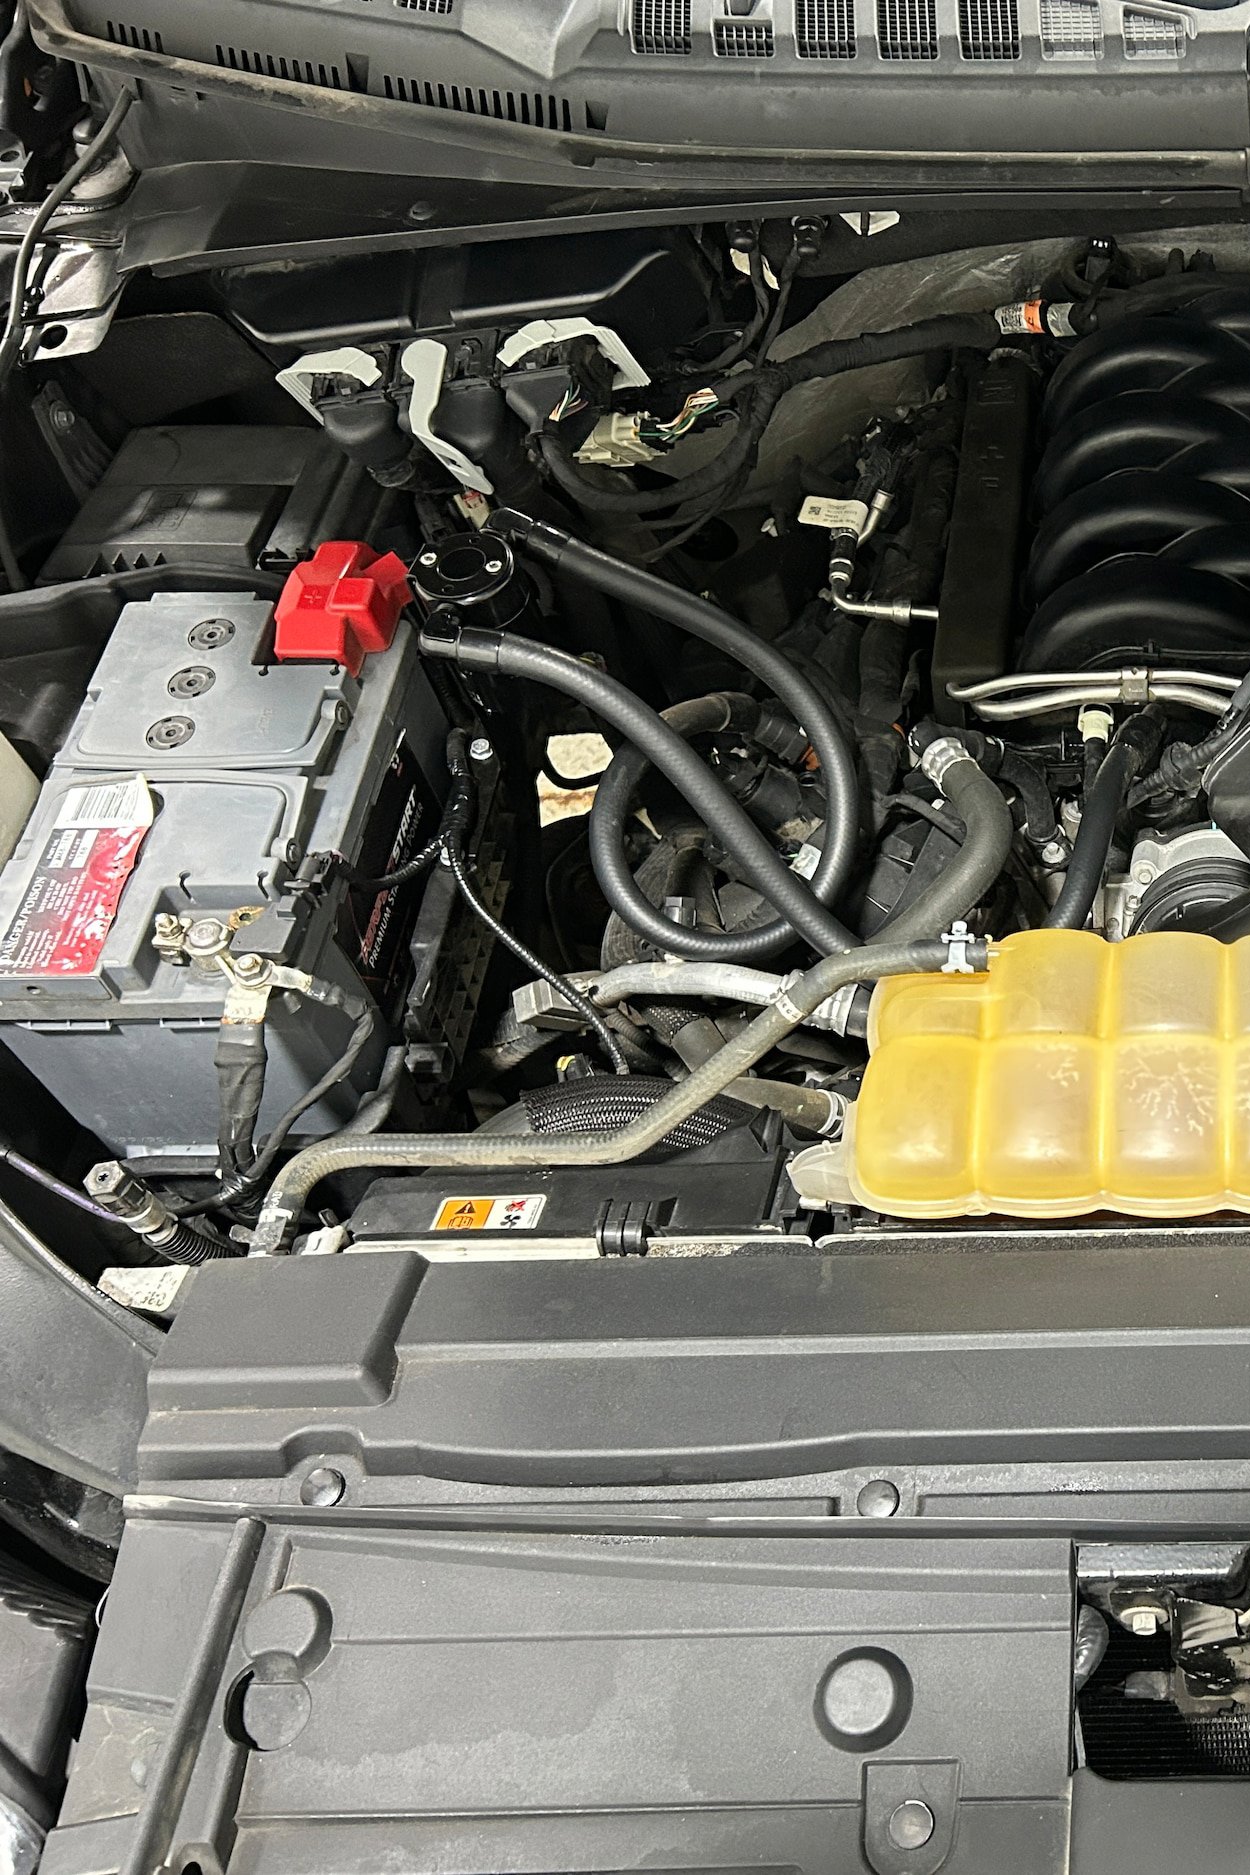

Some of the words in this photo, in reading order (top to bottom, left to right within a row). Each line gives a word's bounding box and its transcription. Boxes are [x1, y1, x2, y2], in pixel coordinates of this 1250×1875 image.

[393, 788, 415, 865] START
[0, 876, 47, 966] DANGER/POISON
[369, 907, 392, 969] PREMIUM
[406, 802, 424, 847] POWER
